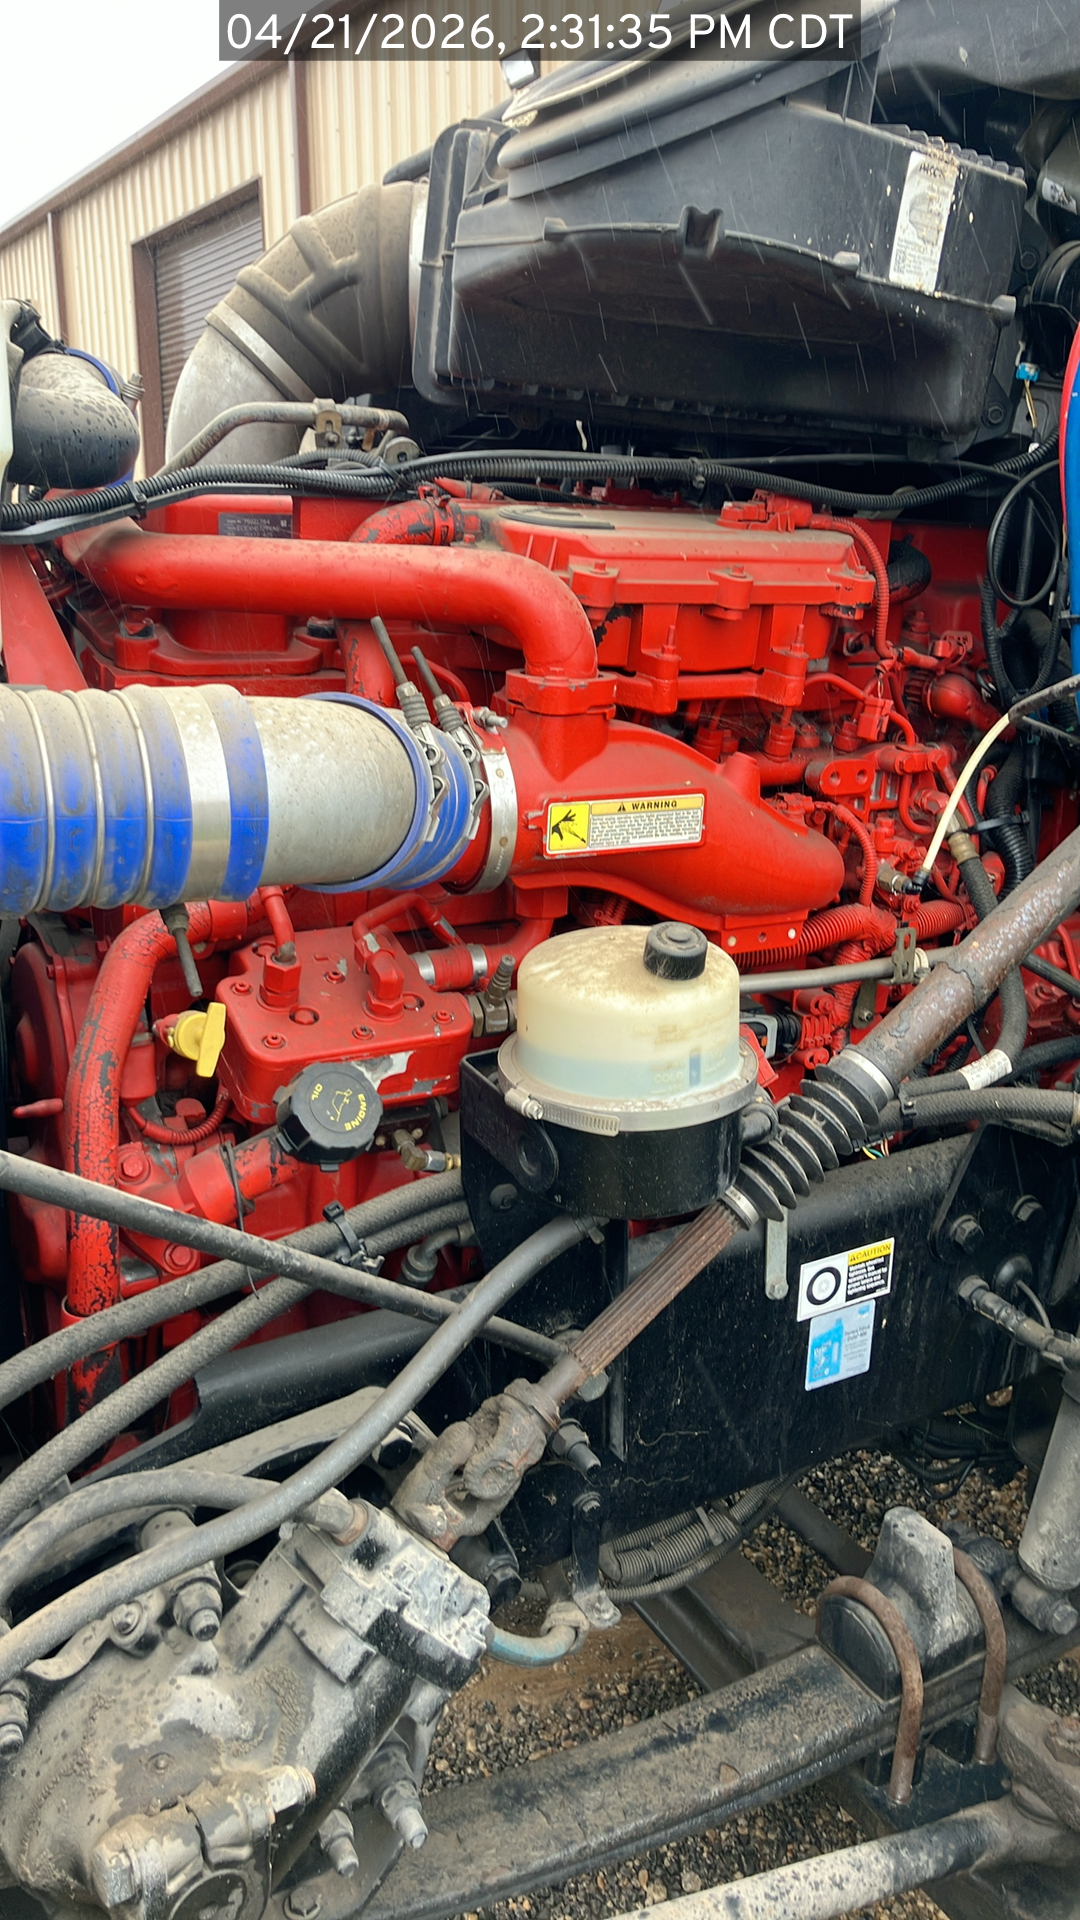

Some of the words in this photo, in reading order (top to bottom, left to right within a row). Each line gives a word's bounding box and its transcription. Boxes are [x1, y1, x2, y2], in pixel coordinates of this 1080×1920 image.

[632, 800, 678, 810] WARNING
[654, 1071, 684, 1083] COLD
[311, 1083, 323, 1101] OIL
[344, 1093, 367, 1131] ENGINE
[857, 1244, 891, 1259] CAUTION
